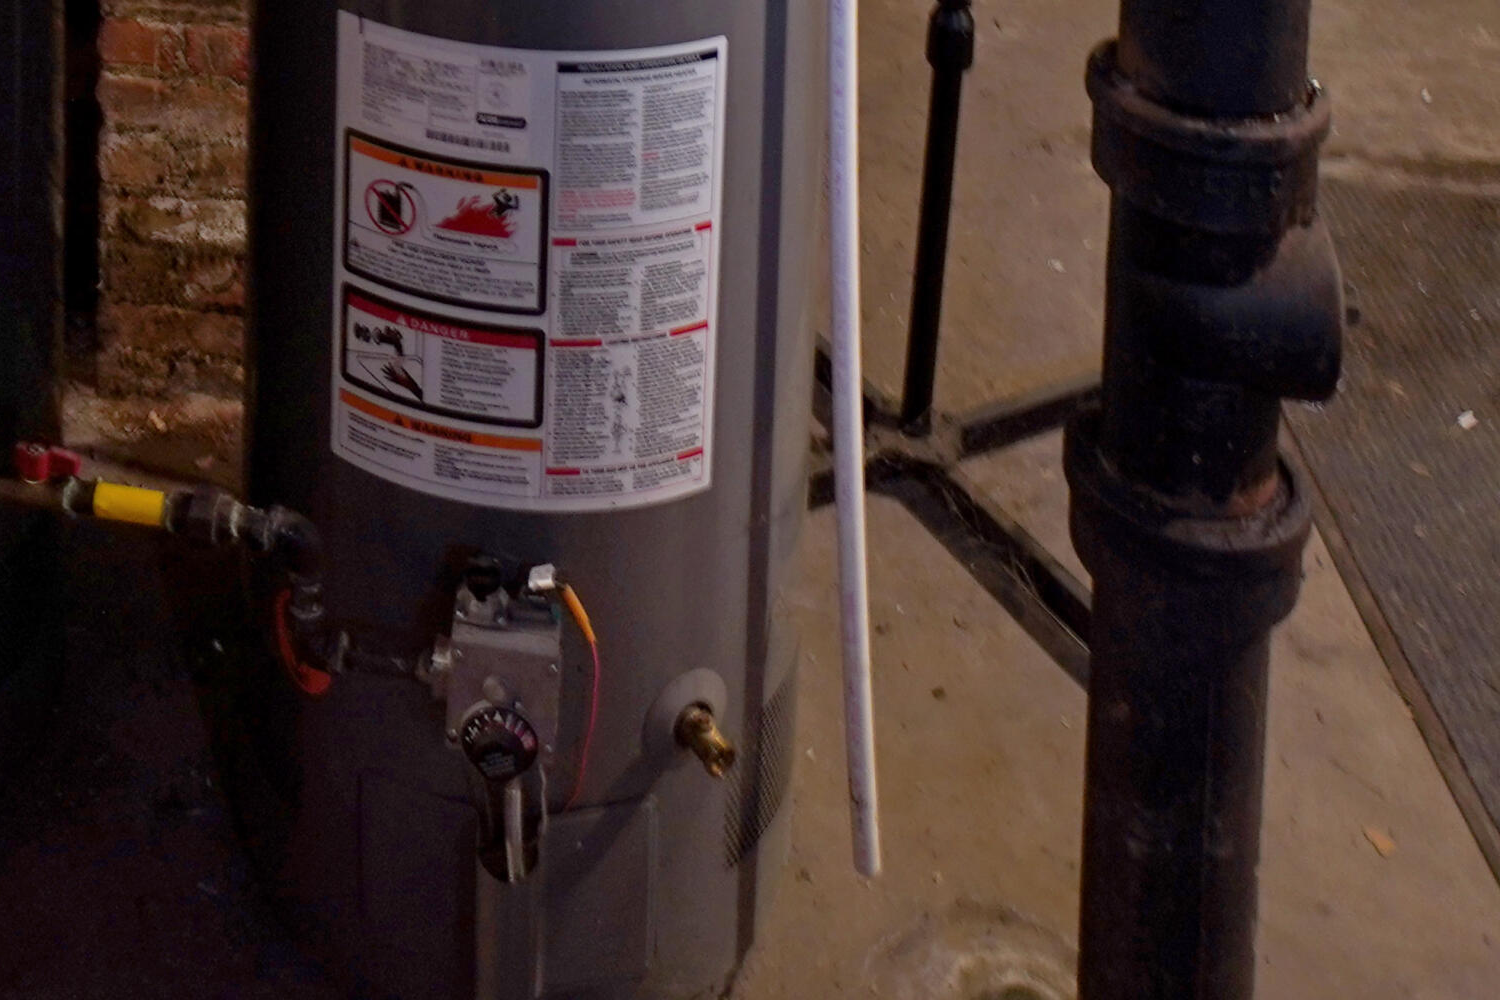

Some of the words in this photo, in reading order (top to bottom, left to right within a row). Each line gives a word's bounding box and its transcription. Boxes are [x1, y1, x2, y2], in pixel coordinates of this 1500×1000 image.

[414, 160, 484, 183] WARNING
[410, 318, 471, 340] DANGER
[409, 420, 473, 443] WARNING
